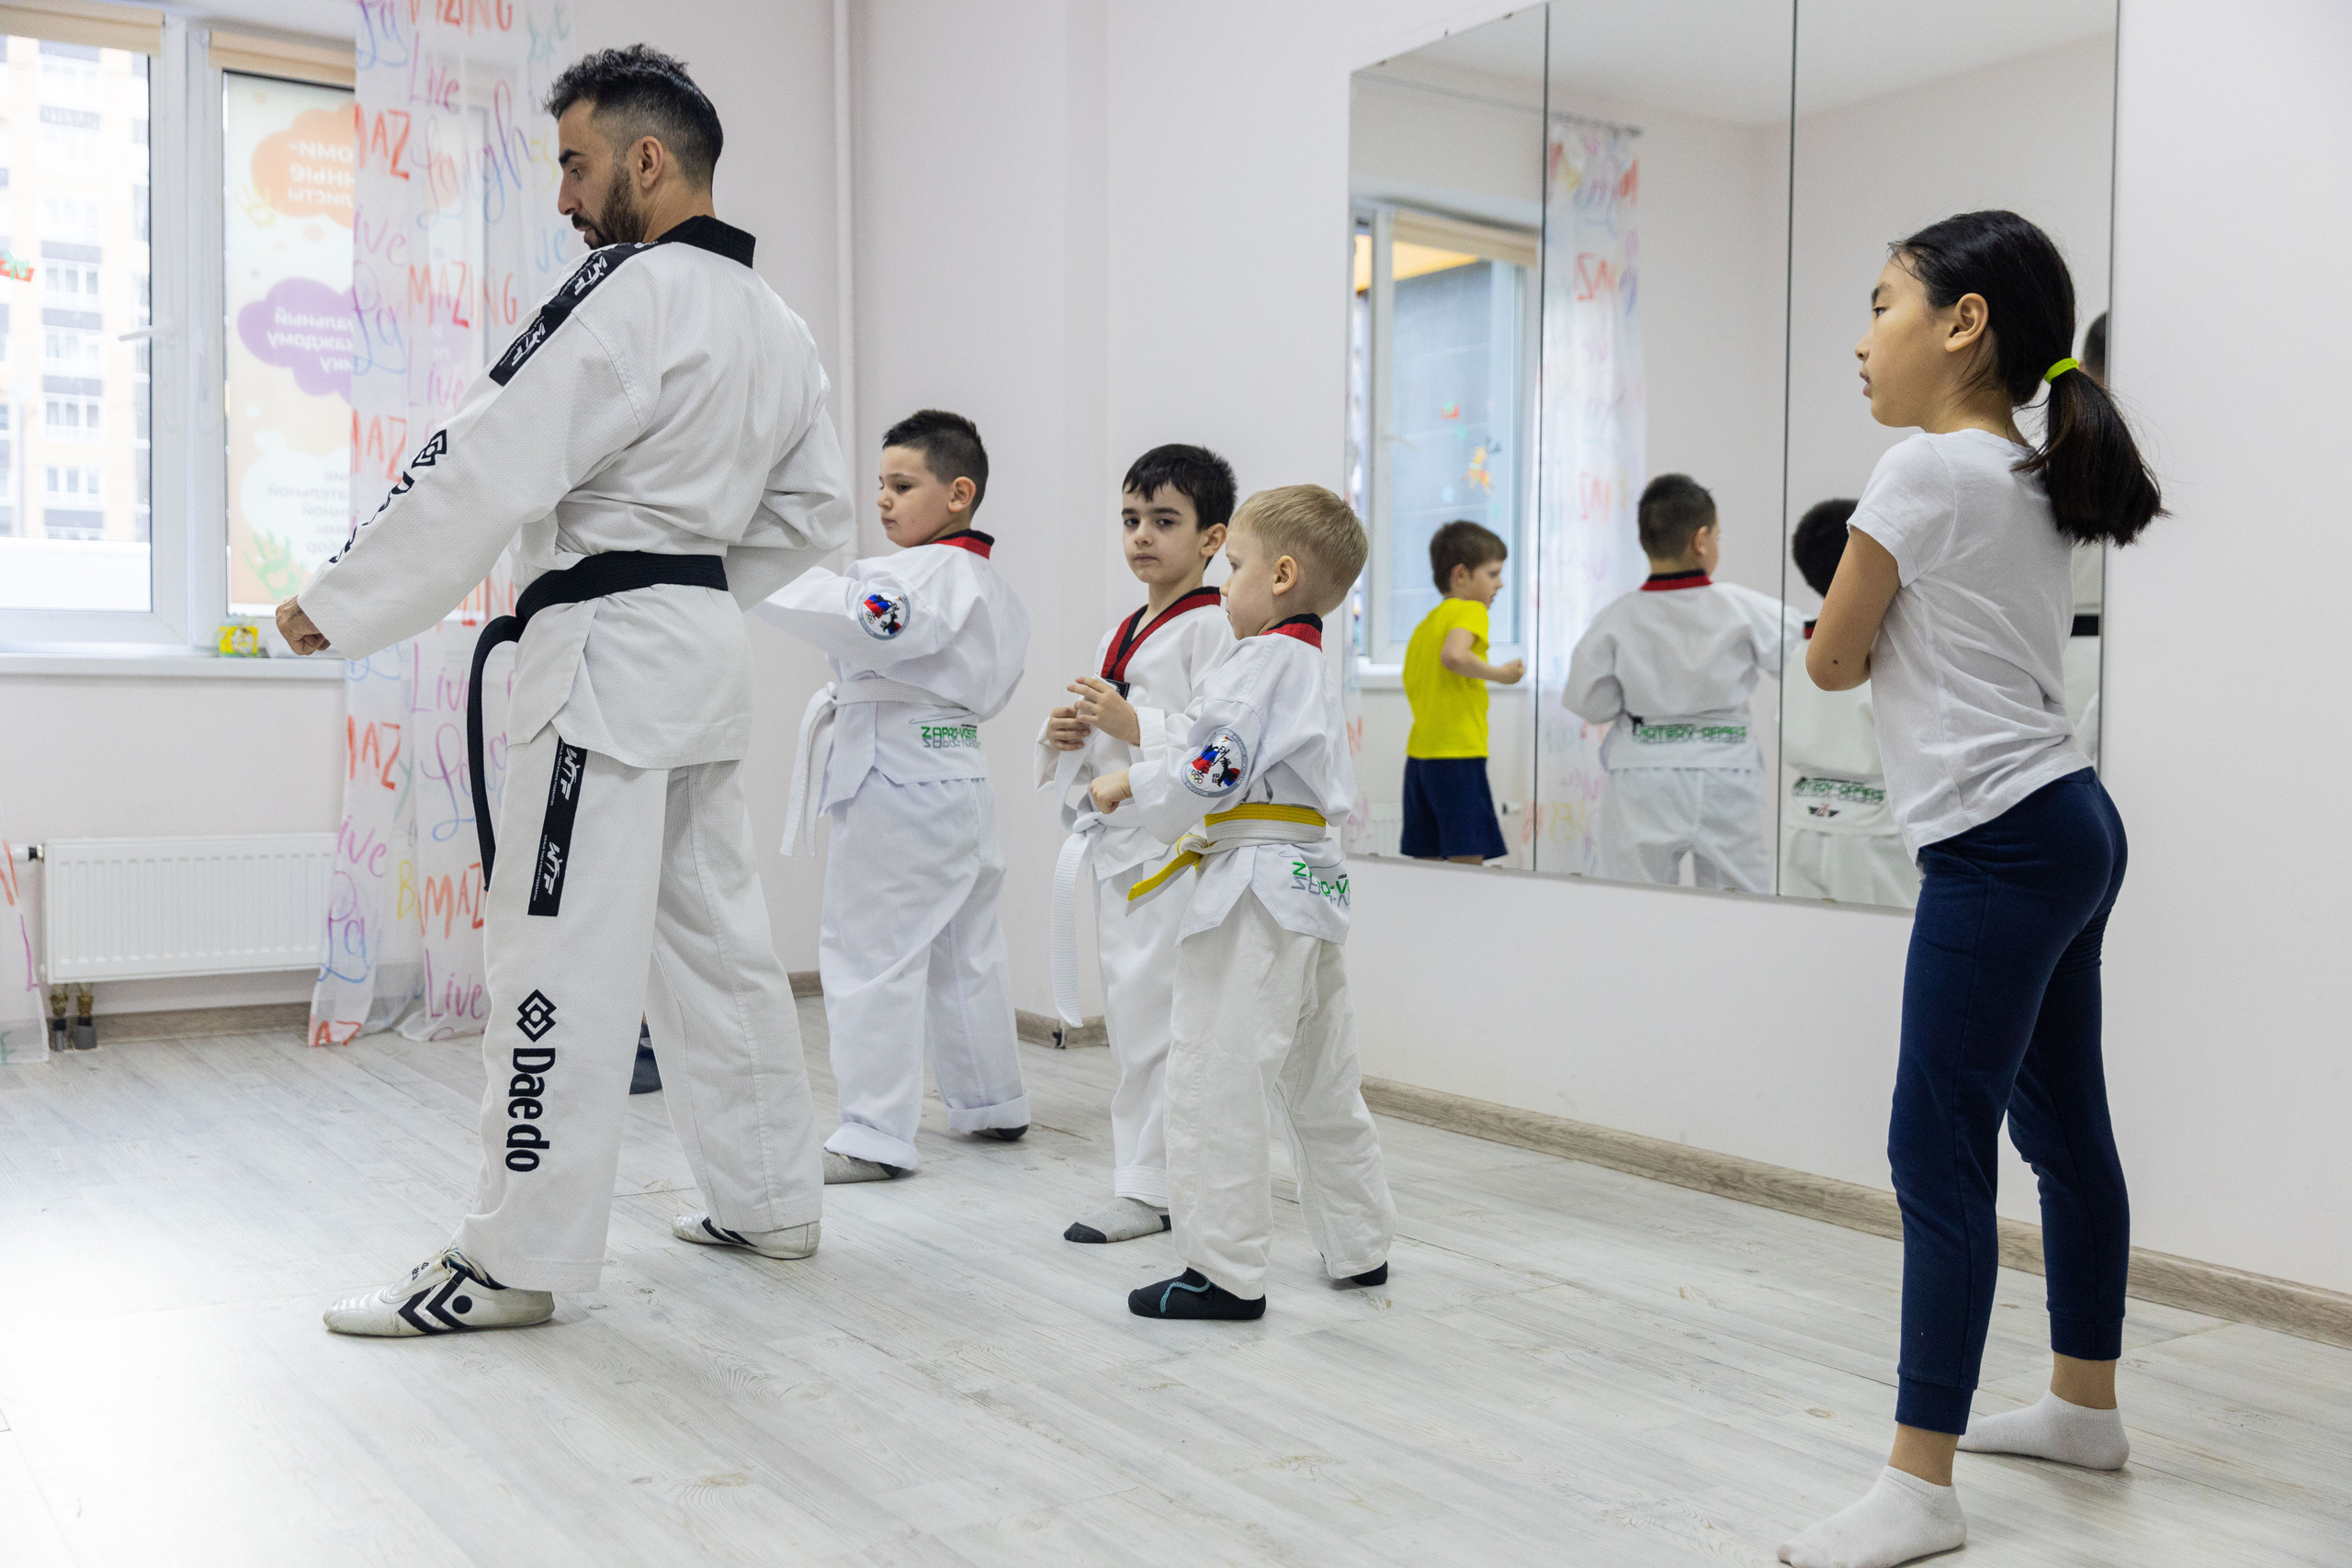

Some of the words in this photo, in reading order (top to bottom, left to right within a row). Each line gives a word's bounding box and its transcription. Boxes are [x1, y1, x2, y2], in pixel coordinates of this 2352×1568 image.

[561, 747, 581, 801] WTF
[544, 841, 564, 896] WTF
[424, 949, 484, 1021] Live
[505, 1047, 556, 1172] Daedo
